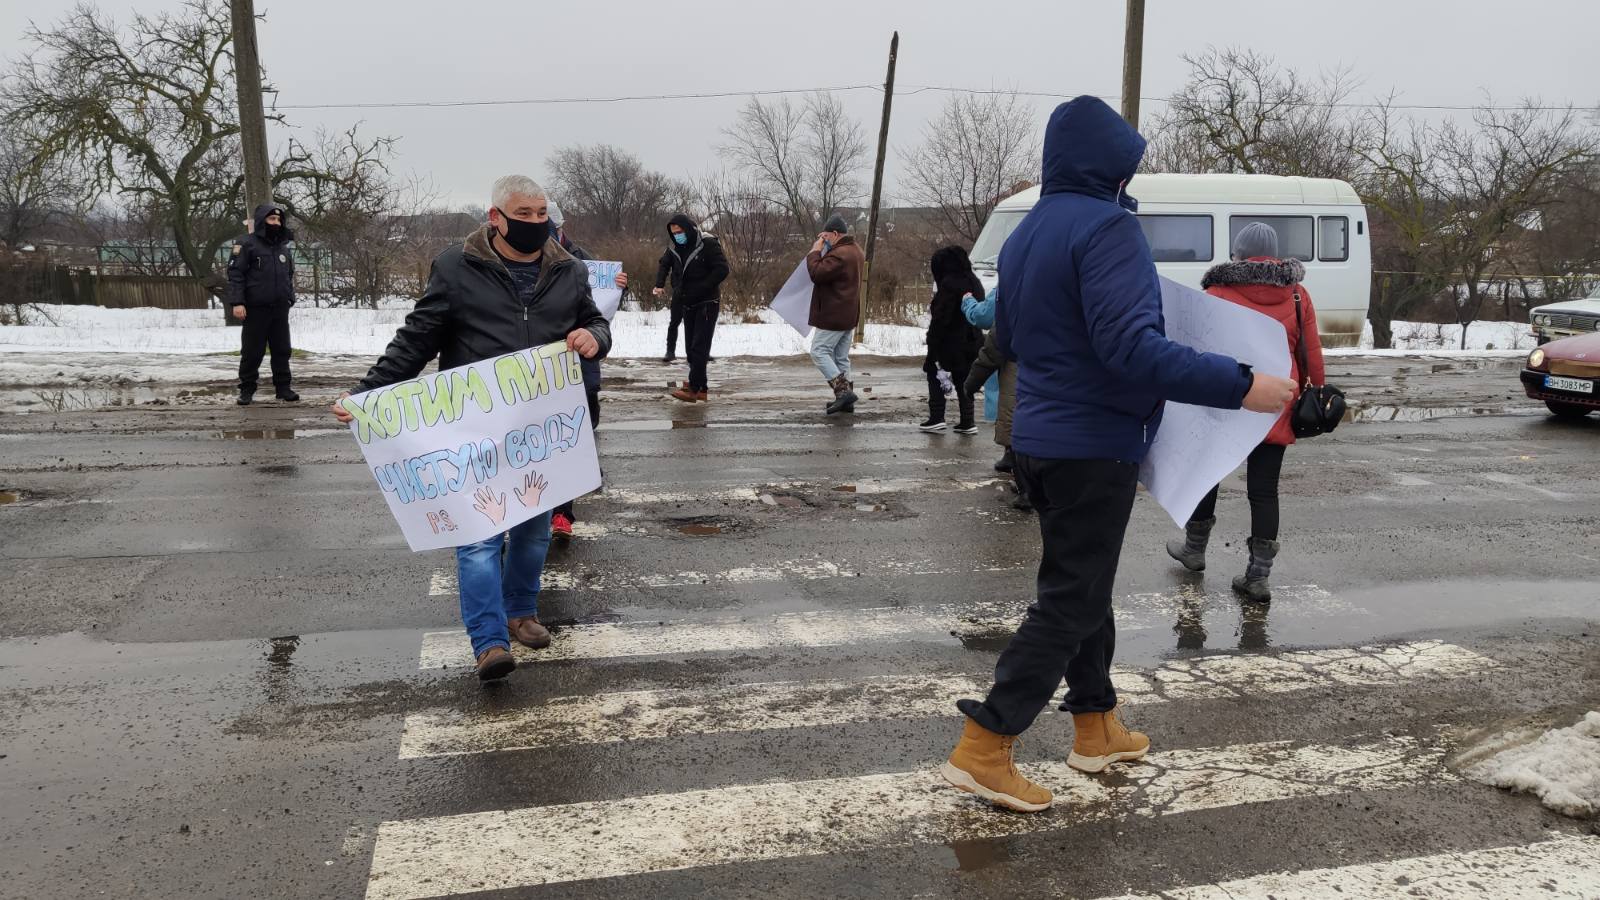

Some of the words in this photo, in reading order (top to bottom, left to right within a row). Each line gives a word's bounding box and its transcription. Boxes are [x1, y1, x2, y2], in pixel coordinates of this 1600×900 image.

[341, 367, 493, 444] ХОТИМ
[494, 340, 583, 405] ПИТЬ
[374, 438, 499, 504] ЧИСТУЮ
[505, 406, 585, 469] ВОДУ
